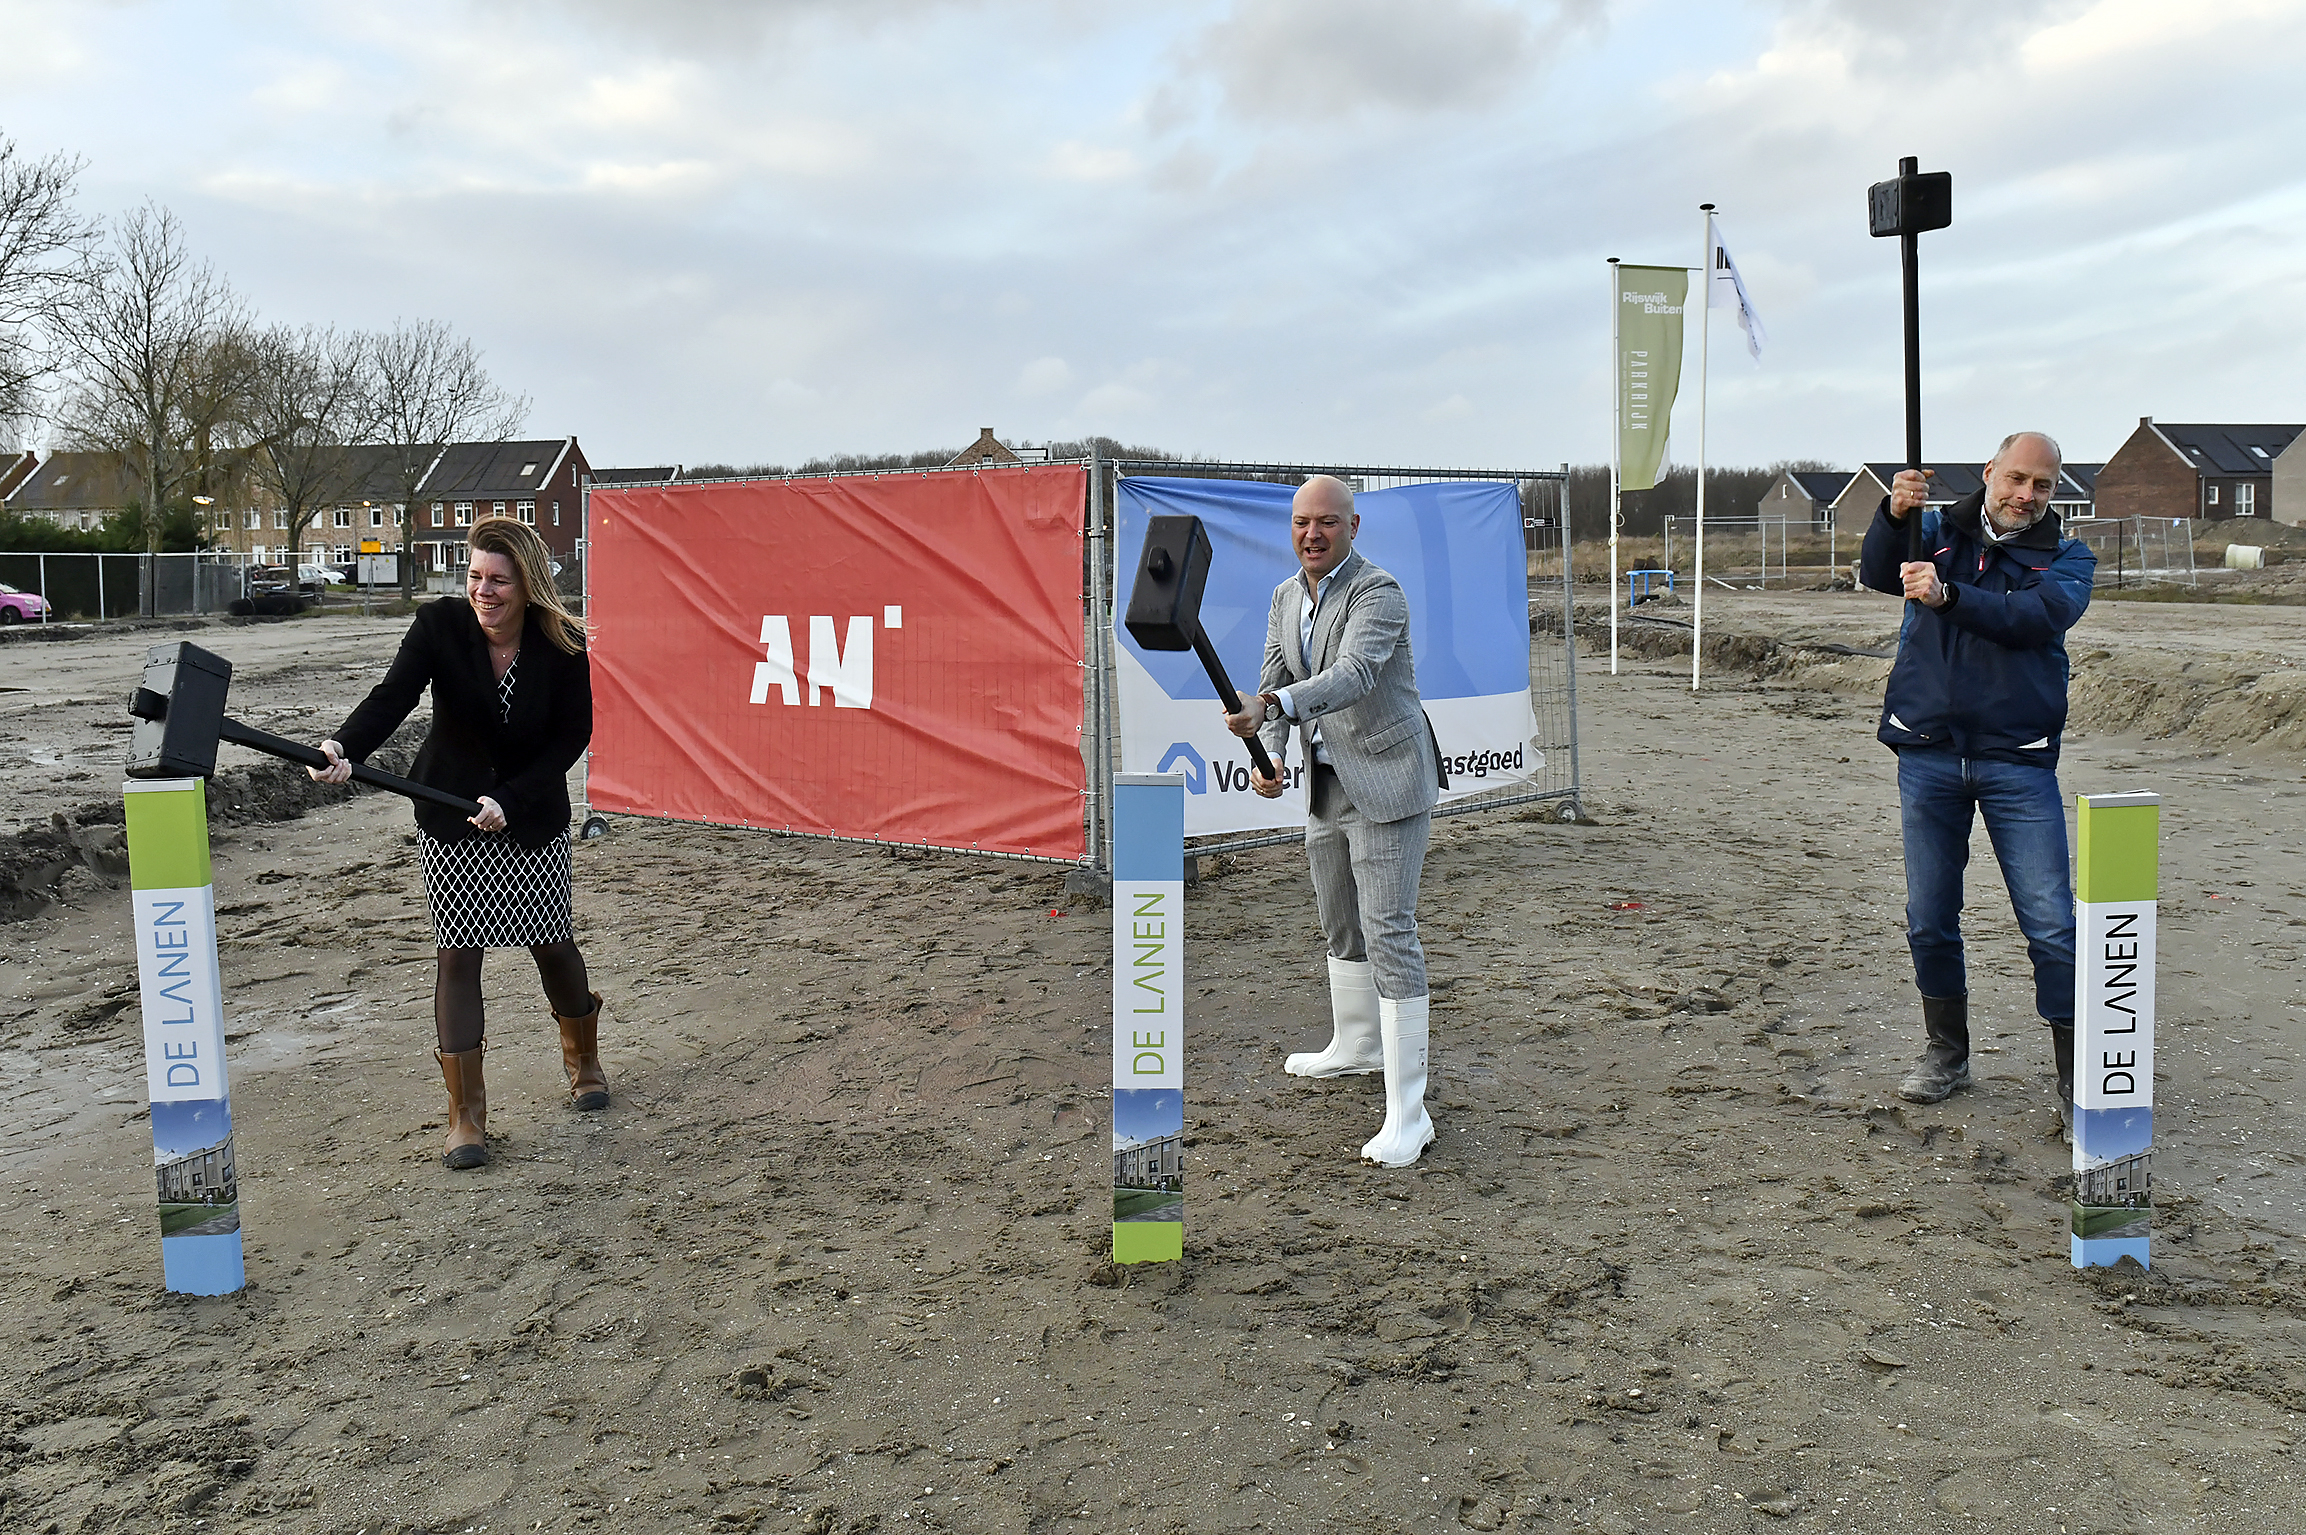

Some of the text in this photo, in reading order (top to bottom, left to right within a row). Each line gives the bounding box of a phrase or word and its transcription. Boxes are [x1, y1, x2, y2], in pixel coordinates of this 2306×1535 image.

[1622, 291, 1668, 305] Rijswijk
[1644, 303, 1683, 315] Buiten
[1630, 350, 1648, 430] PARKRIJK
[1442, 741, 1524, 778] astgoed
[151, 901, 200, 1088] DE LANEN
[1132, 893, 1165, 1075] DE LANEN
[2102, 913, 2139, 1095] DE LANEN
